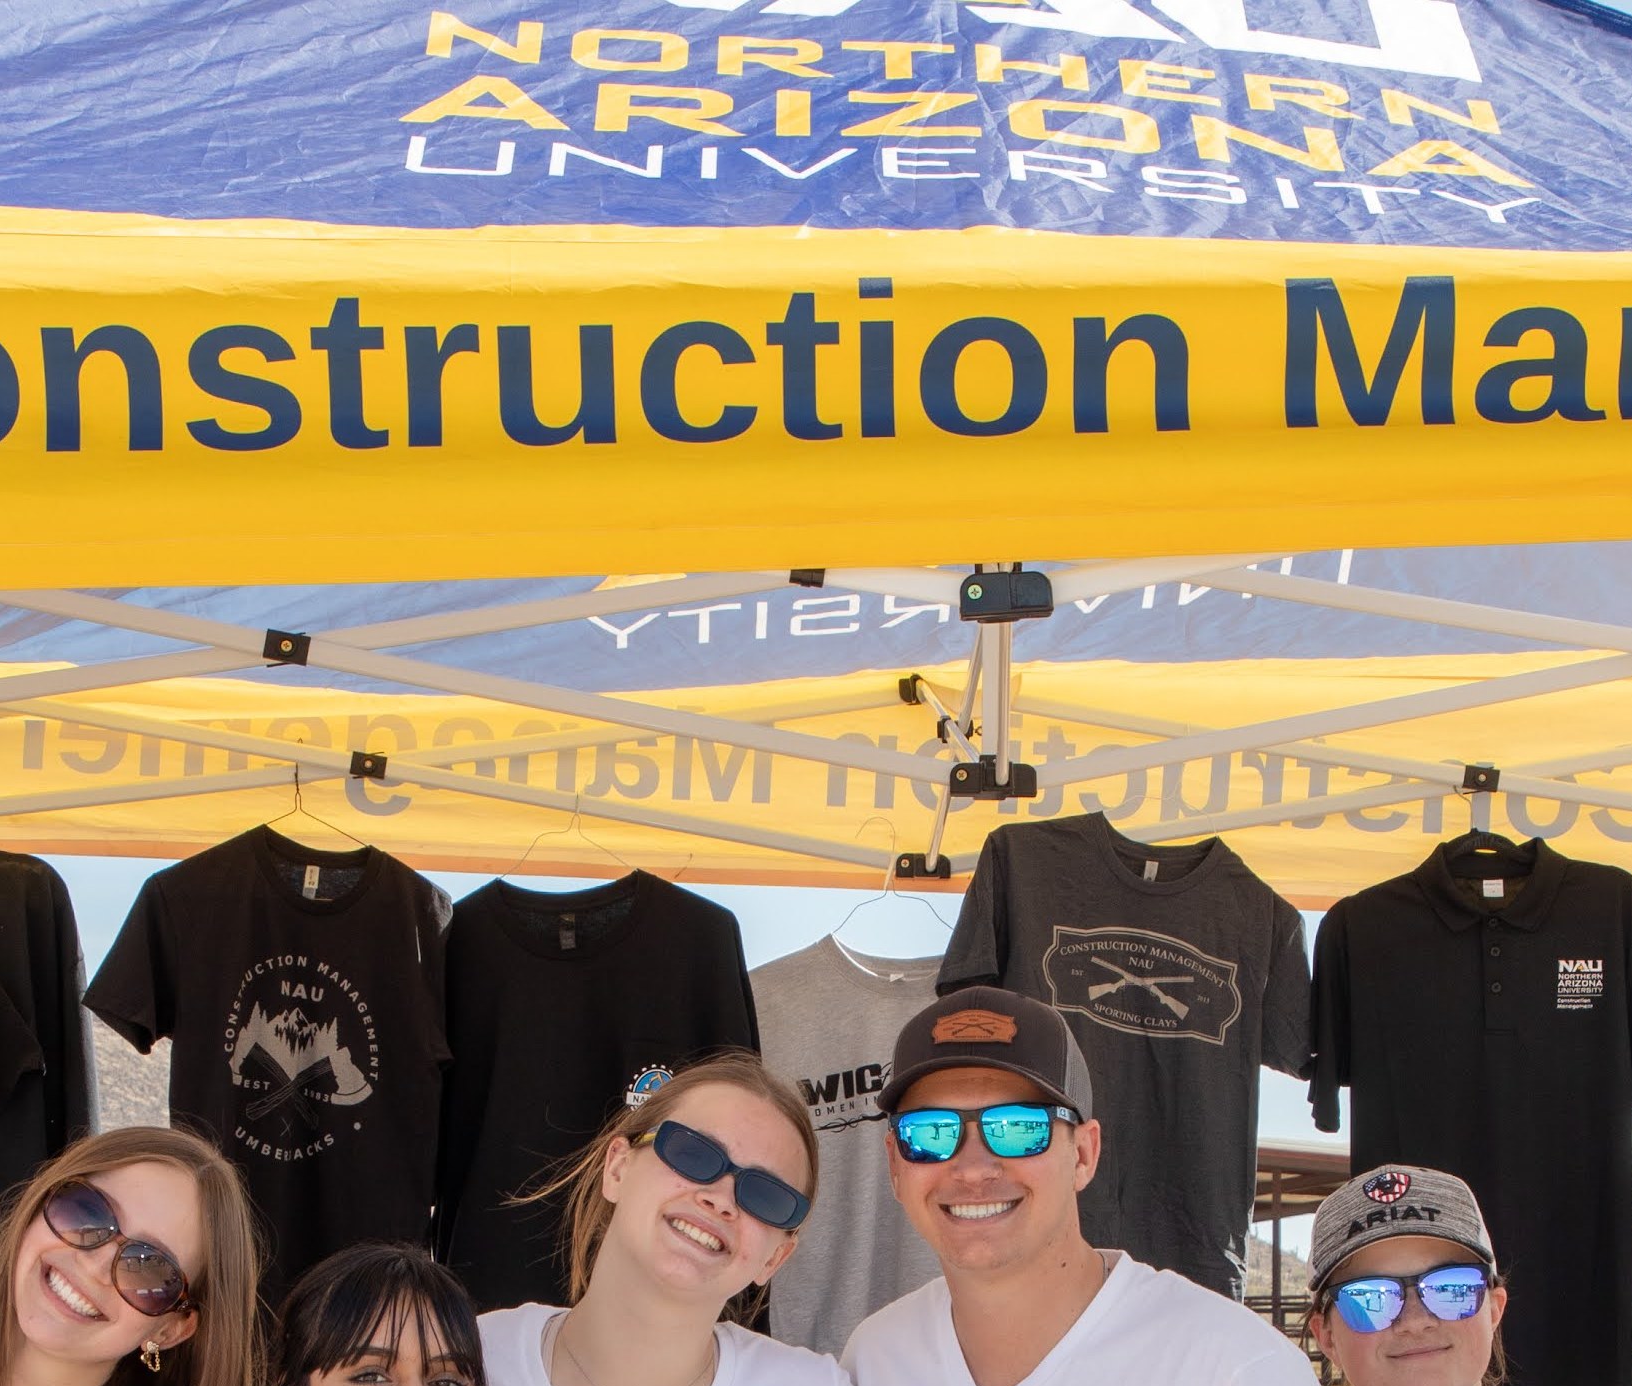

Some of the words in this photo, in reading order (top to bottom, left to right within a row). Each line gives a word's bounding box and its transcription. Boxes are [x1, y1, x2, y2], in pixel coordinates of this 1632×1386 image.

[426, 10, 1503, 134] NORTHERN
[426, 74, 1536, 188] ARIZONA
[405, 137, 1541, 224] UNIVERSITY
[1060, 941, 1147, 956] CONSTRUCTION
[1150, 947, 1227, 988] MANAGEMENT
[1129, 957, 1155, 969] NAU
[1558, 960, 1603, 972] NAU
[281, 980, 324, 1002] NAU
[317, 962, 378, 1080] MANAGEMENT
[1094, 1003, 1141, 1023] SPORTING
[1144, 1016, 1178, 1029] CLAYS
[244, 1080, 270, 1090] EST
[796, 1063, 882, 1106] WIC
[1346, 1205, 1441, 1239] ARIAT
